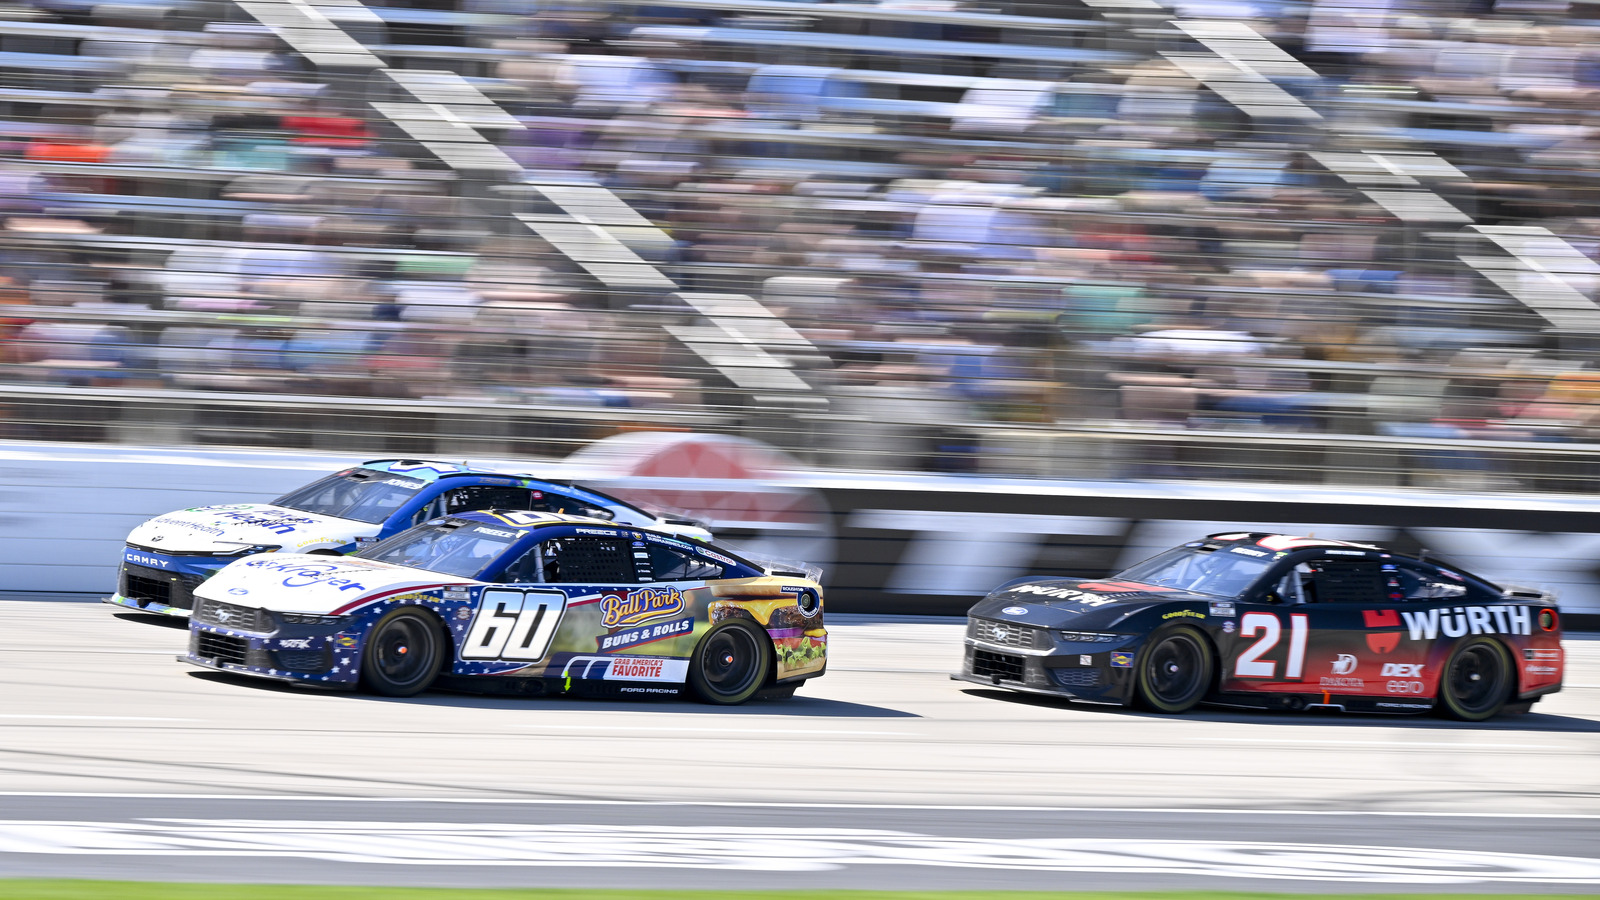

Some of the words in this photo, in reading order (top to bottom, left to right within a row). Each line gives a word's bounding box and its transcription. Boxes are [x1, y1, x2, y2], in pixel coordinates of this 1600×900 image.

[473, 526, 516, 538] PREECE
[576, 528, 618, 536] PREECE
[126, 553, 169, 568] CAMRY
[705, 550, 734, 565] Castrol
[602, 594, 642, 625] Ball
[639, 588, 683, 612] Park
[459, 586, 568, 663] 60
[1400, 605, 1532, 640] WÜRTH
[601, 631, 640, 650] BUNS
[640, 628, 651, 640] &
[652, 620, 689, 637] ROLLS
[1233, 611, 1310, 680] 21
[631, 659, 663, 667] AMERICA'S
[1380, 662, 1426, 678] DEX
[612, 665, 662, 677] FAVORITE
[1319, 676, 1365, 688] DAKOTA
